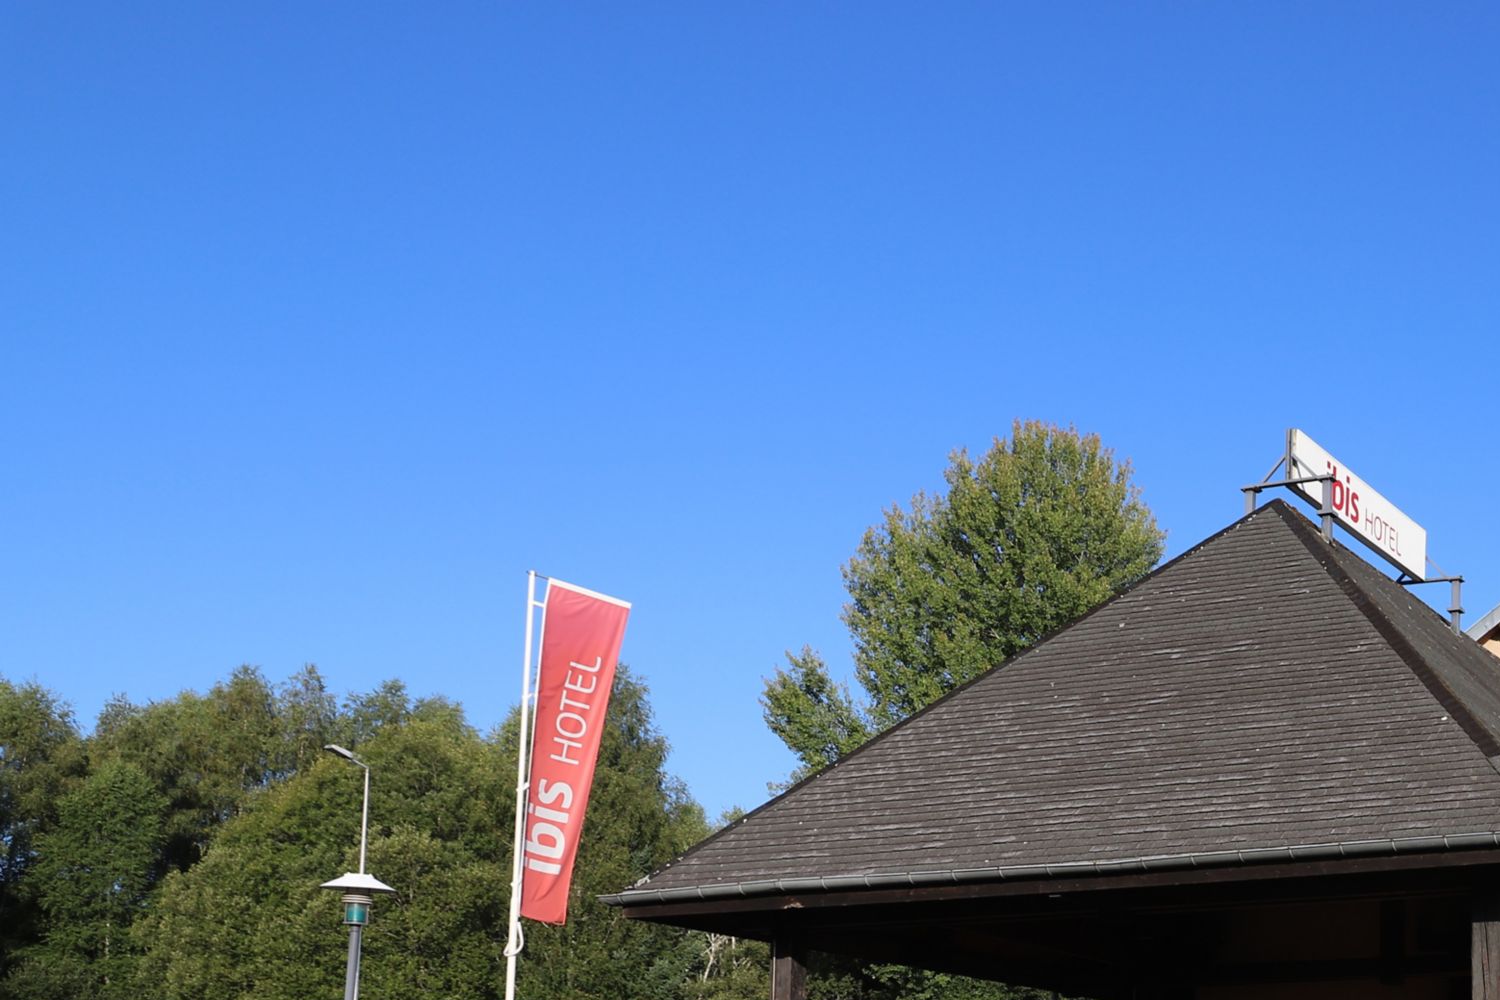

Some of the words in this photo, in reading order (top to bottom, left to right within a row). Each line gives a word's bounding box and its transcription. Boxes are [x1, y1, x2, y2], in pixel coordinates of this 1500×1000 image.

[1365, 507, 1401, 556] HOTEL
[524, 778, 573, 875] ibis
[550, 656, 602, 765] HOTEL
